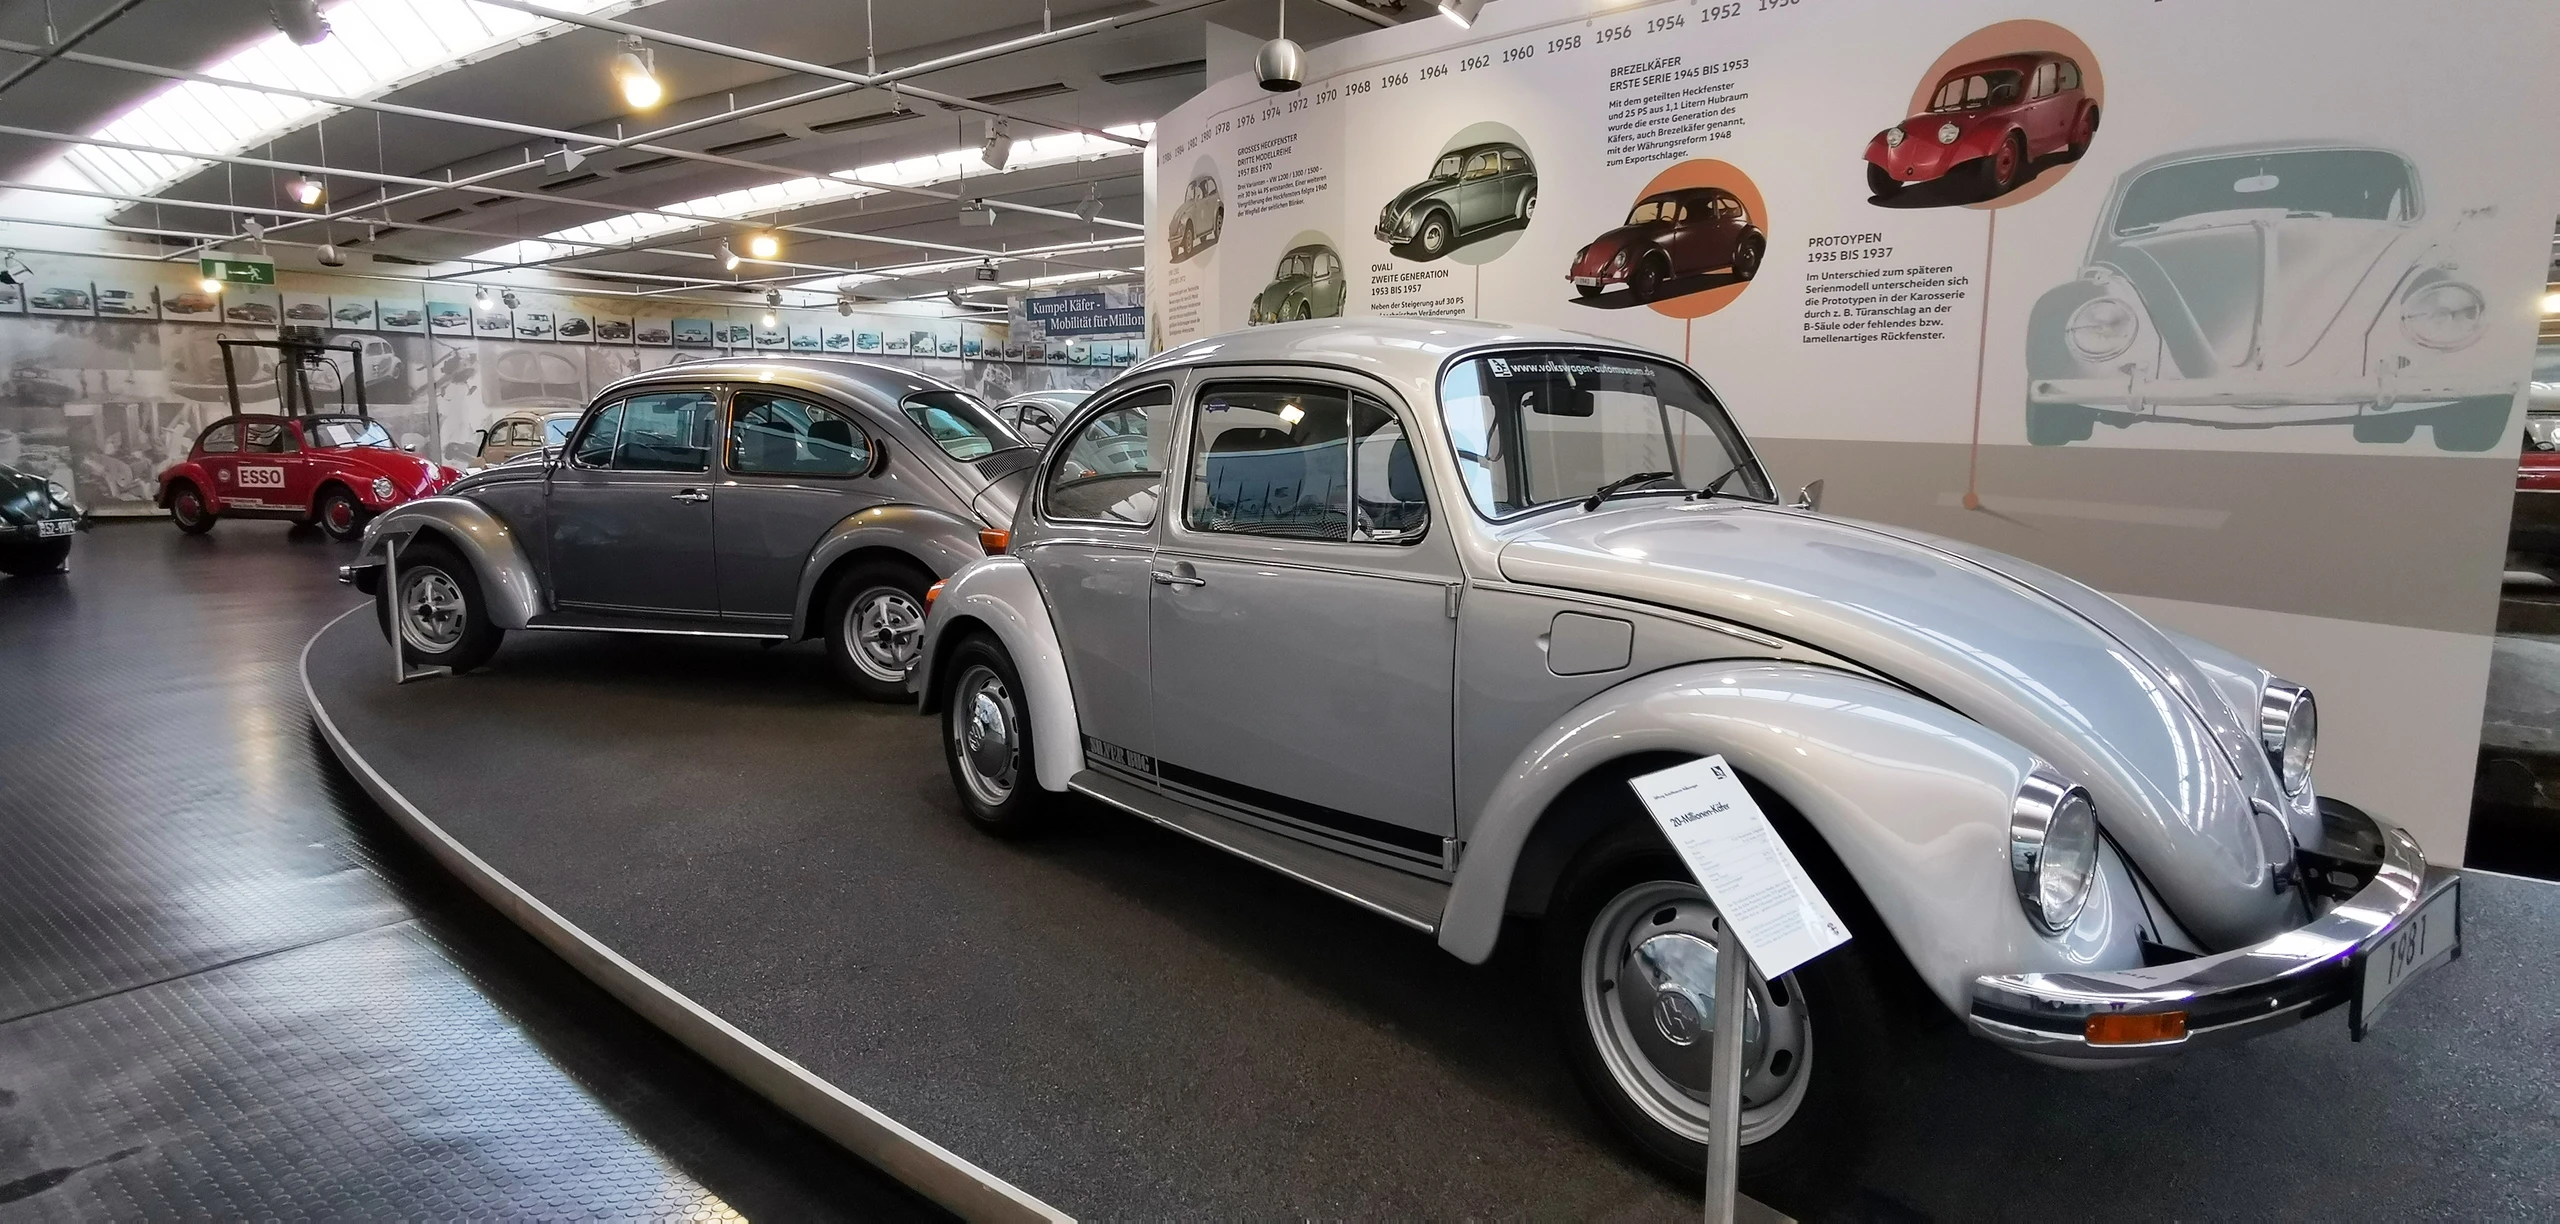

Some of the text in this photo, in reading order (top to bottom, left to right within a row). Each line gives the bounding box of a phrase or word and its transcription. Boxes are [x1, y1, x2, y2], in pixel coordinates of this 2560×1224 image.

[1215, 122, 1230, 135] 1978
[1237, 114, 1255, 128] 1976
[1262, 107, 1280, 121] 1974
[1289, 98, 1308, 113] 1972
[1316, 89, 1337, 104] 1970
[1345, 80, 1371, 97] 1968
[1382, 73, 1408, 88] 1966
[1420, 64, 1448, 80] 1964
[1460, 55, 1490, 72] 1962
[1502, 45, 1534, 63] 1960
[1547, 35, 1582, 54] 1958
[1596, 25, 1632, 44] 1956
[1647, 14, 1685, 34] 1954
[1701, 2, 1741, 23] 1952
[1759, 0, 1799, 11] 19
[1611, 56, 1681, 77] BREZELKÄFER
[1610, 59, 1749, 91] ERSTE SERIE 1945 BIS 1953
[1609, 83, 1734, 108] Mit dem geteilten Heckfenster
[1609, 92, 1748, 120] und 25 PS aus 1,1 Litern Hubraum
[1608, 107, 1736, 132] wurde die erste Generation des
[1608, 118, 1745, 143] Käfers, auch Brezelkäfer genannt,
[1238, 133, 1297, 156] GROSSES HECKFENSTER
[1607, 131, 1732, 155] mit der Währungsreform 1948
[1238, 146, 1291, 166] DRITTE MODELLREIHE
[1606, 150, 1688, 166] zum Exportschlager.
[1238, 169, 1249, 177] 1957
[1260, 163, 1272, 172] 1970
[1247, 180, 1265, 188] Varianten
[1809, 233, 1881, 247] PROTOYPEN
[1808, 247, 1893, 262] 1935 BIS 1937
[1372, 263, 1392, 272] OVALI
[1807, 266, 1952, 281] Im Unterschied zum späteren
[1371, 270, 1449, 284] ZWEITE GENERATION
[1806, 276, 1968, 293] Serienmodell unterscheiden sich
[1372, 284, 1421, 296] 1953 BIS 1957
[1402, 300, 1433, 308] Steigerung
[1805, 290, 1965, 306] die Prototypen in der Karosserie
[1033, 300, 1068, 315] Kumpel
[1070, 298, 1095, 312] Käfer
[1419, 308, 1465, 316] Veränderungen
[1804, 310, 1831, 318] durch
[1856, 306, 1916, 316] Türanschlag
[1934, 304, 1952, 313] der
[1051, 316, 1092, 330] Mobilität
[1093, 316, 1108, 327] für
[1804, 318, 1943, 331] B-Säule oder fehlendes bzw.
[1803, 331, 1945, 344] lamellenartiges Rückfenster.
[1511, 361, 1656, 376] www.volkswagen-automuseum.de
[241, 470, 281, 484] ESSO
[2388, 914, 2426, 984] 1981
